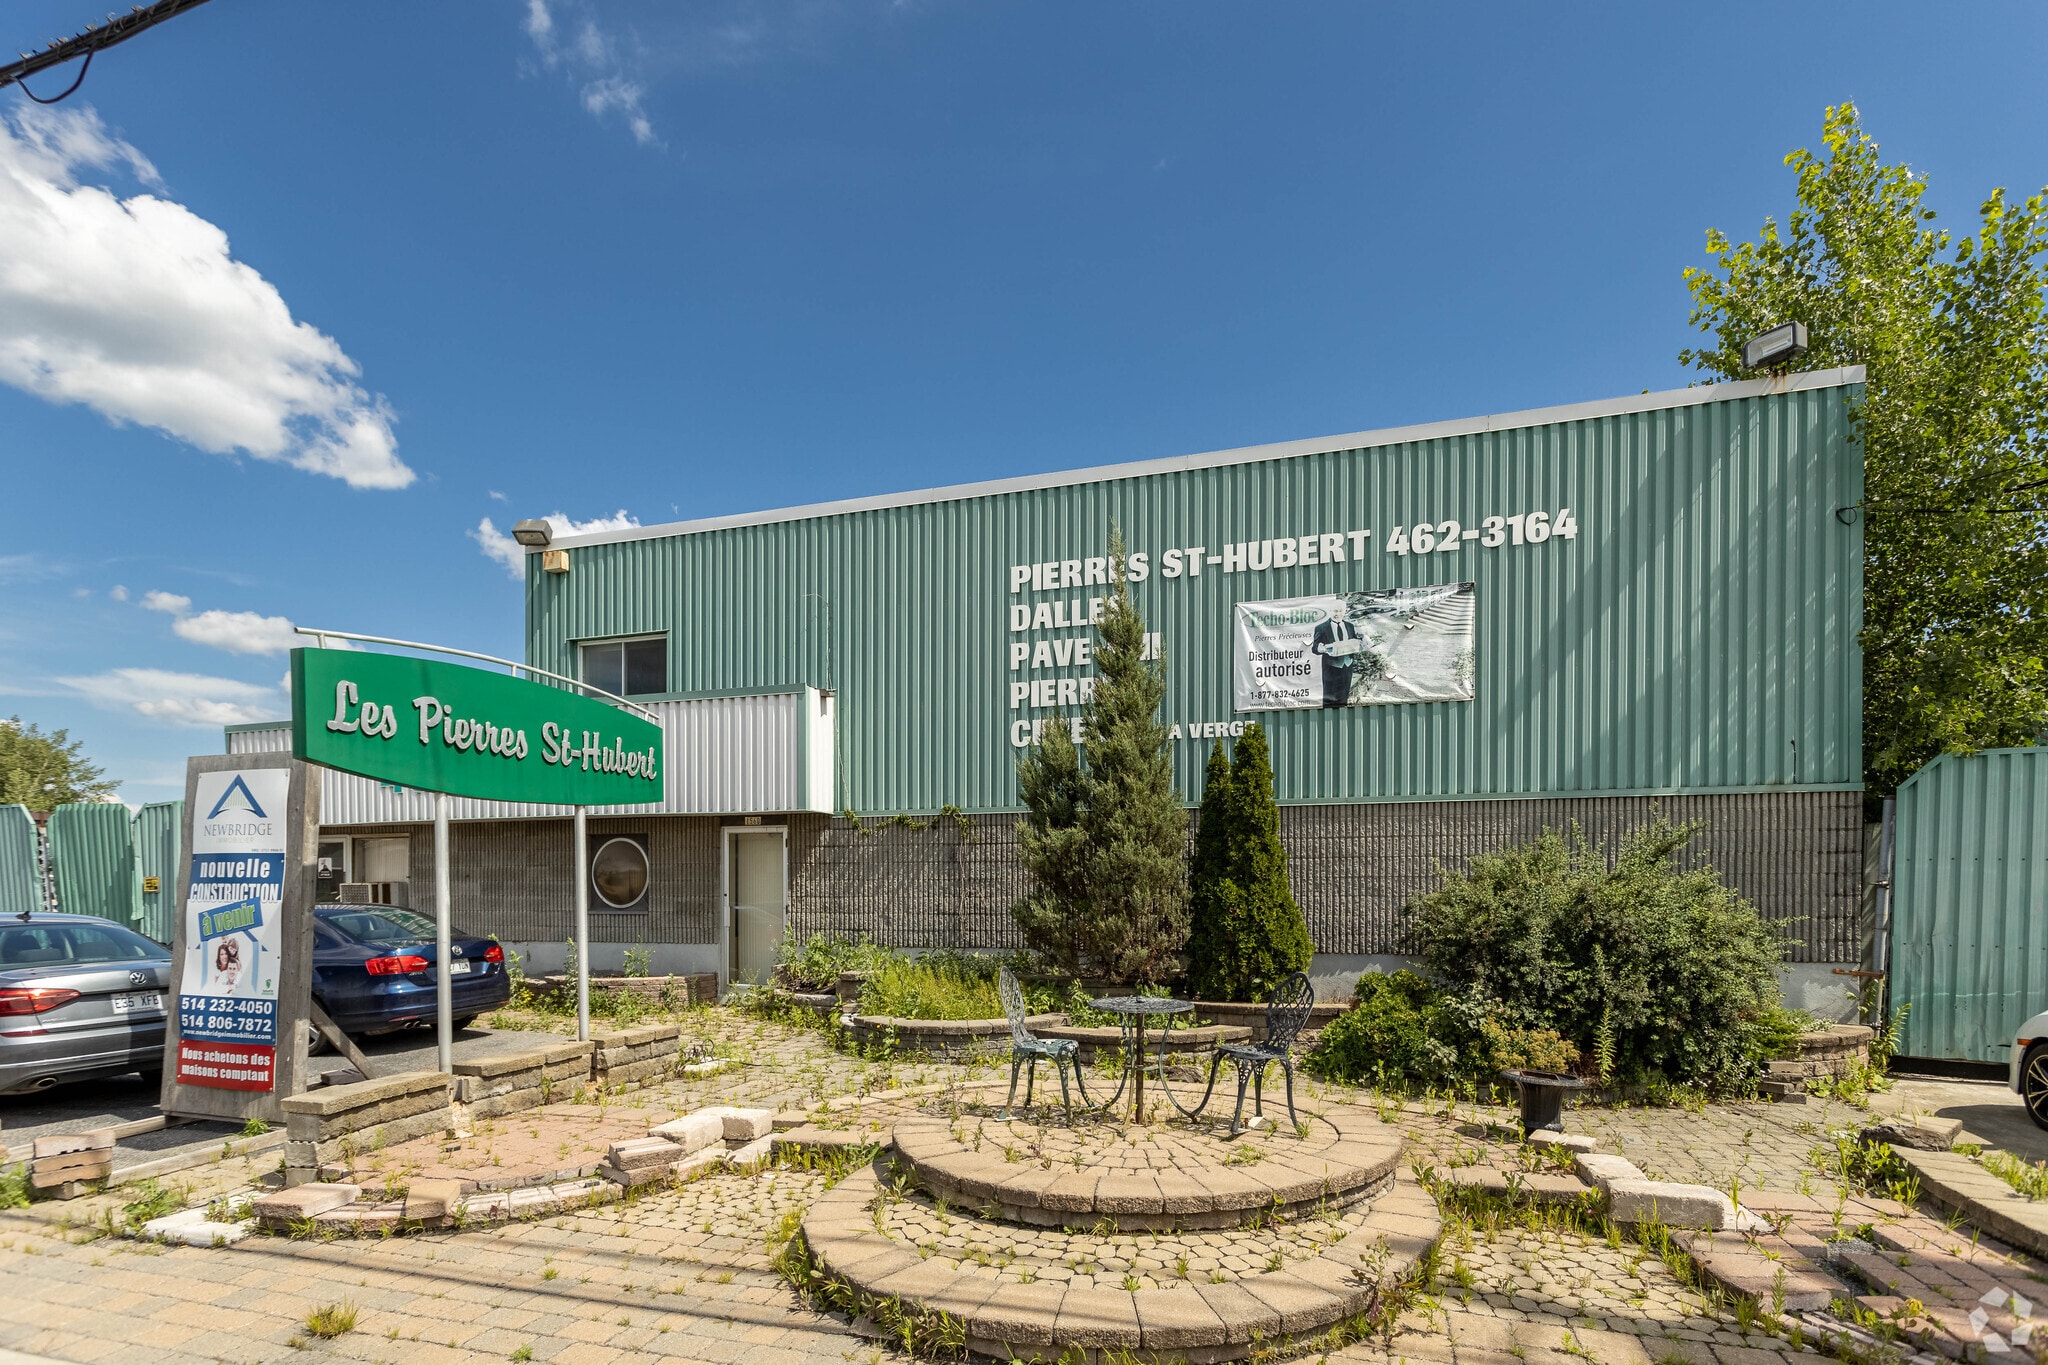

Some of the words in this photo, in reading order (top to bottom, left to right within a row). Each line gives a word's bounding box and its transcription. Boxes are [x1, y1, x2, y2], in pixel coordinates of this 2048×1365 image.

[1162, 529, 1371, 578] ST-HUBERT
[1386, 508, 1578, 556] 462-3164
[1250, 608, 1318, 628] Techo-Bloc
[1249, 649, 1304, 662] Distributeur
[1256, 660, 1311, 678] autorisé
[1010, 677, 1106, 709] PIERR
[1251, 688, 1310, 700] 1-877-832-4625
[327, 680, 398, 739] Les
[413, 696, 529, 760] Pierres
[541, 721, 657, 780] St-Hubert
[204, 823, 273, 837] NEWBRIDGE
[200, 858, 271, 879] nouvelle
[190, 882, 280, 904] CONSTRUCTION
[202, 912, 213, 936] à
[213, 903, 256, 933] venir
[181, 997, 206, 1011] 514
[209, 998, 273, 1015] 232-4050
[181, 1014, 204, 1028] 514
[208, 1015, 272, 1032] 806-7872
[182, 1047, 202, 1061] Nous
[204, 1050, 248, 1065] achetons
[251, 1053, 271, 1066] des
[181, 1064, 218, 1078] maisons
[220, 1067, 270, 1082] comptant
